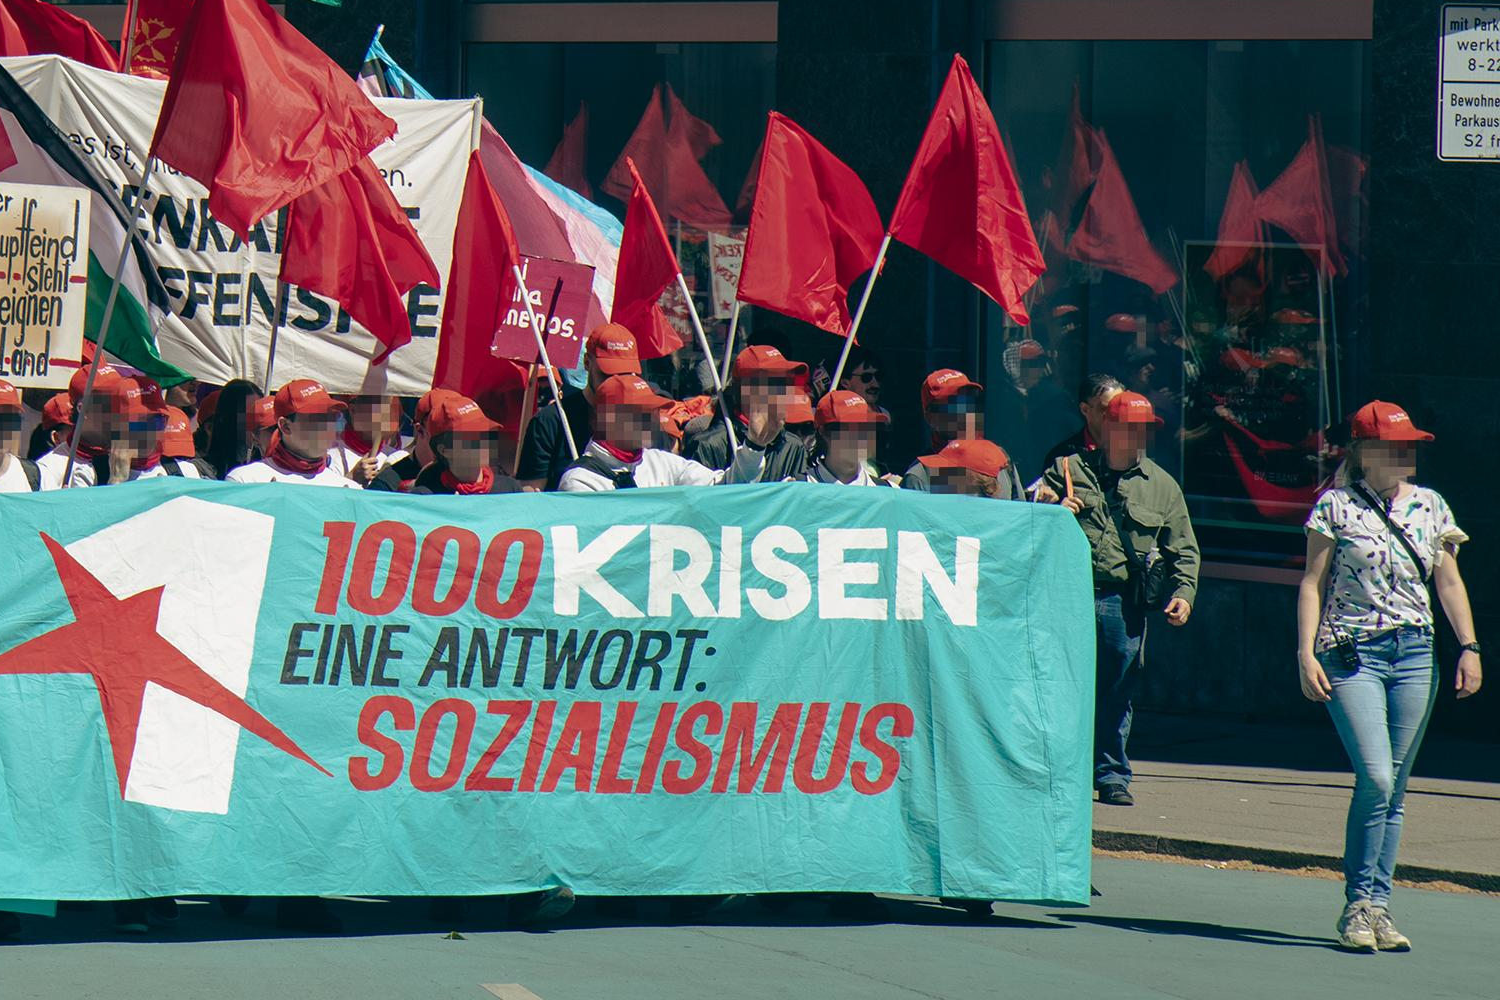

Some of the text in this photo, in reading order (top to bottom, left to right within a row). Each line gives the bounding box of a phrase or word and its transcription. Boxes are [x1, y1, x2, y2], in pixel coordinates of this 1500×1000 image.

[1450, 18, 1468, 31] mit
[1464, 134, 1483, 147] S2
[27, 258, 71, 293] steht
[314, 520, 981, 627] 1000 KRISEN
[279, 622, 717, 692] EINE ANTWORT:
[347, 695, 915, 797] SOZIALISMUS
